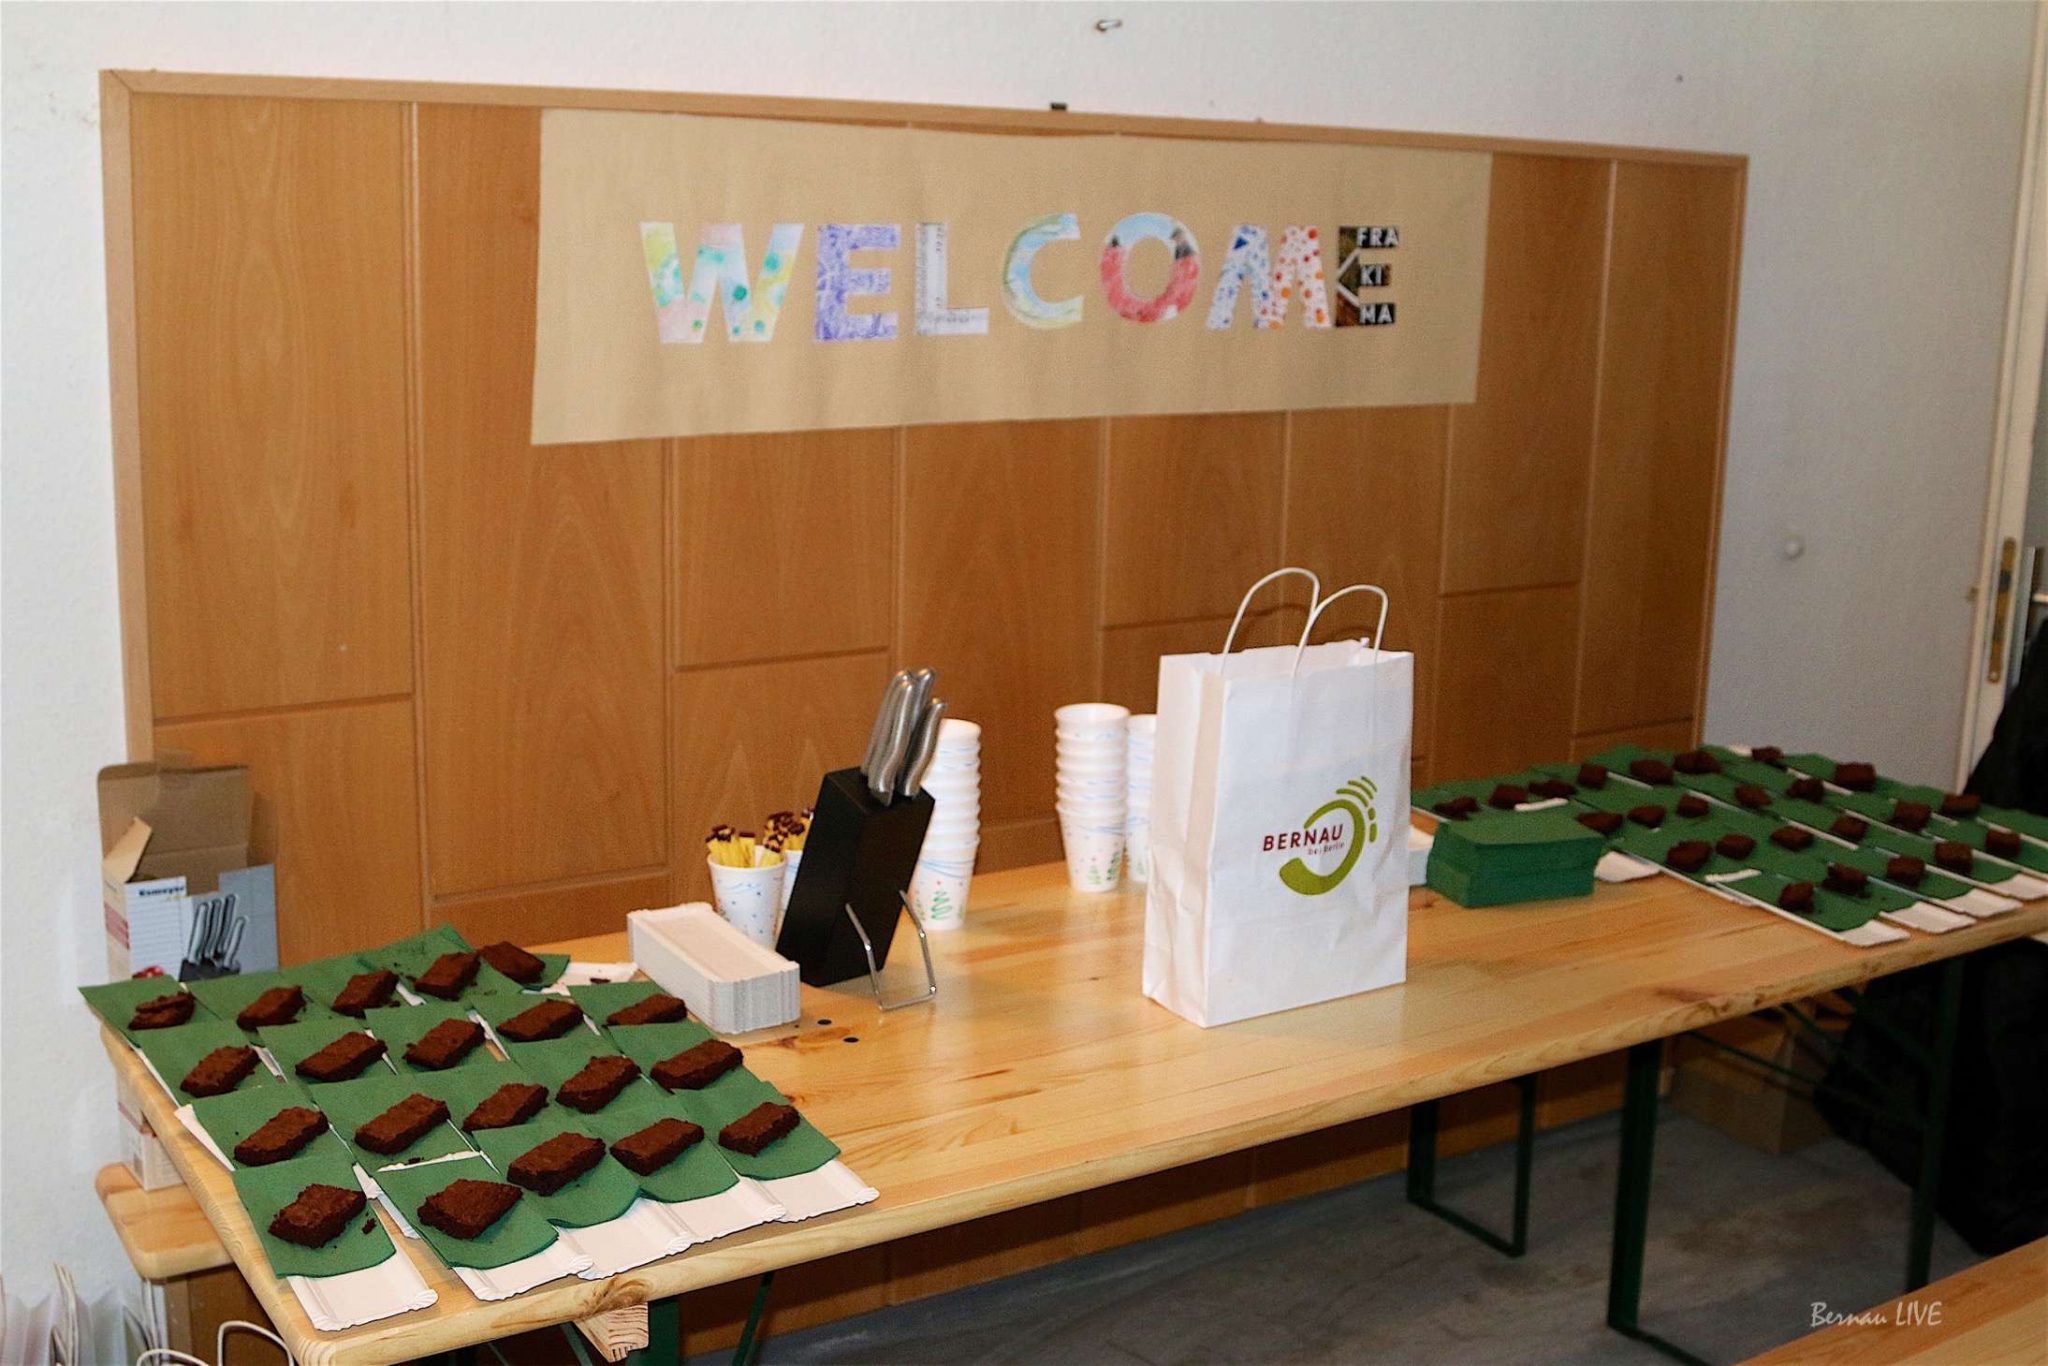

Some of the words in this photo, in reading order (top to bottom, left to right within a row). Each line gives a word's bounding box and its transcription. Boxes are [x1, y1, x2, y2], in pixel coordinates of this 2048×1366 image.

[1356, 226, 1399, 247] FRA
[639, 211, 1399, 344] WELCOME
[1360, 265, 1383, 286] KI
[1263, 824, 1344, 852] BERNAU
